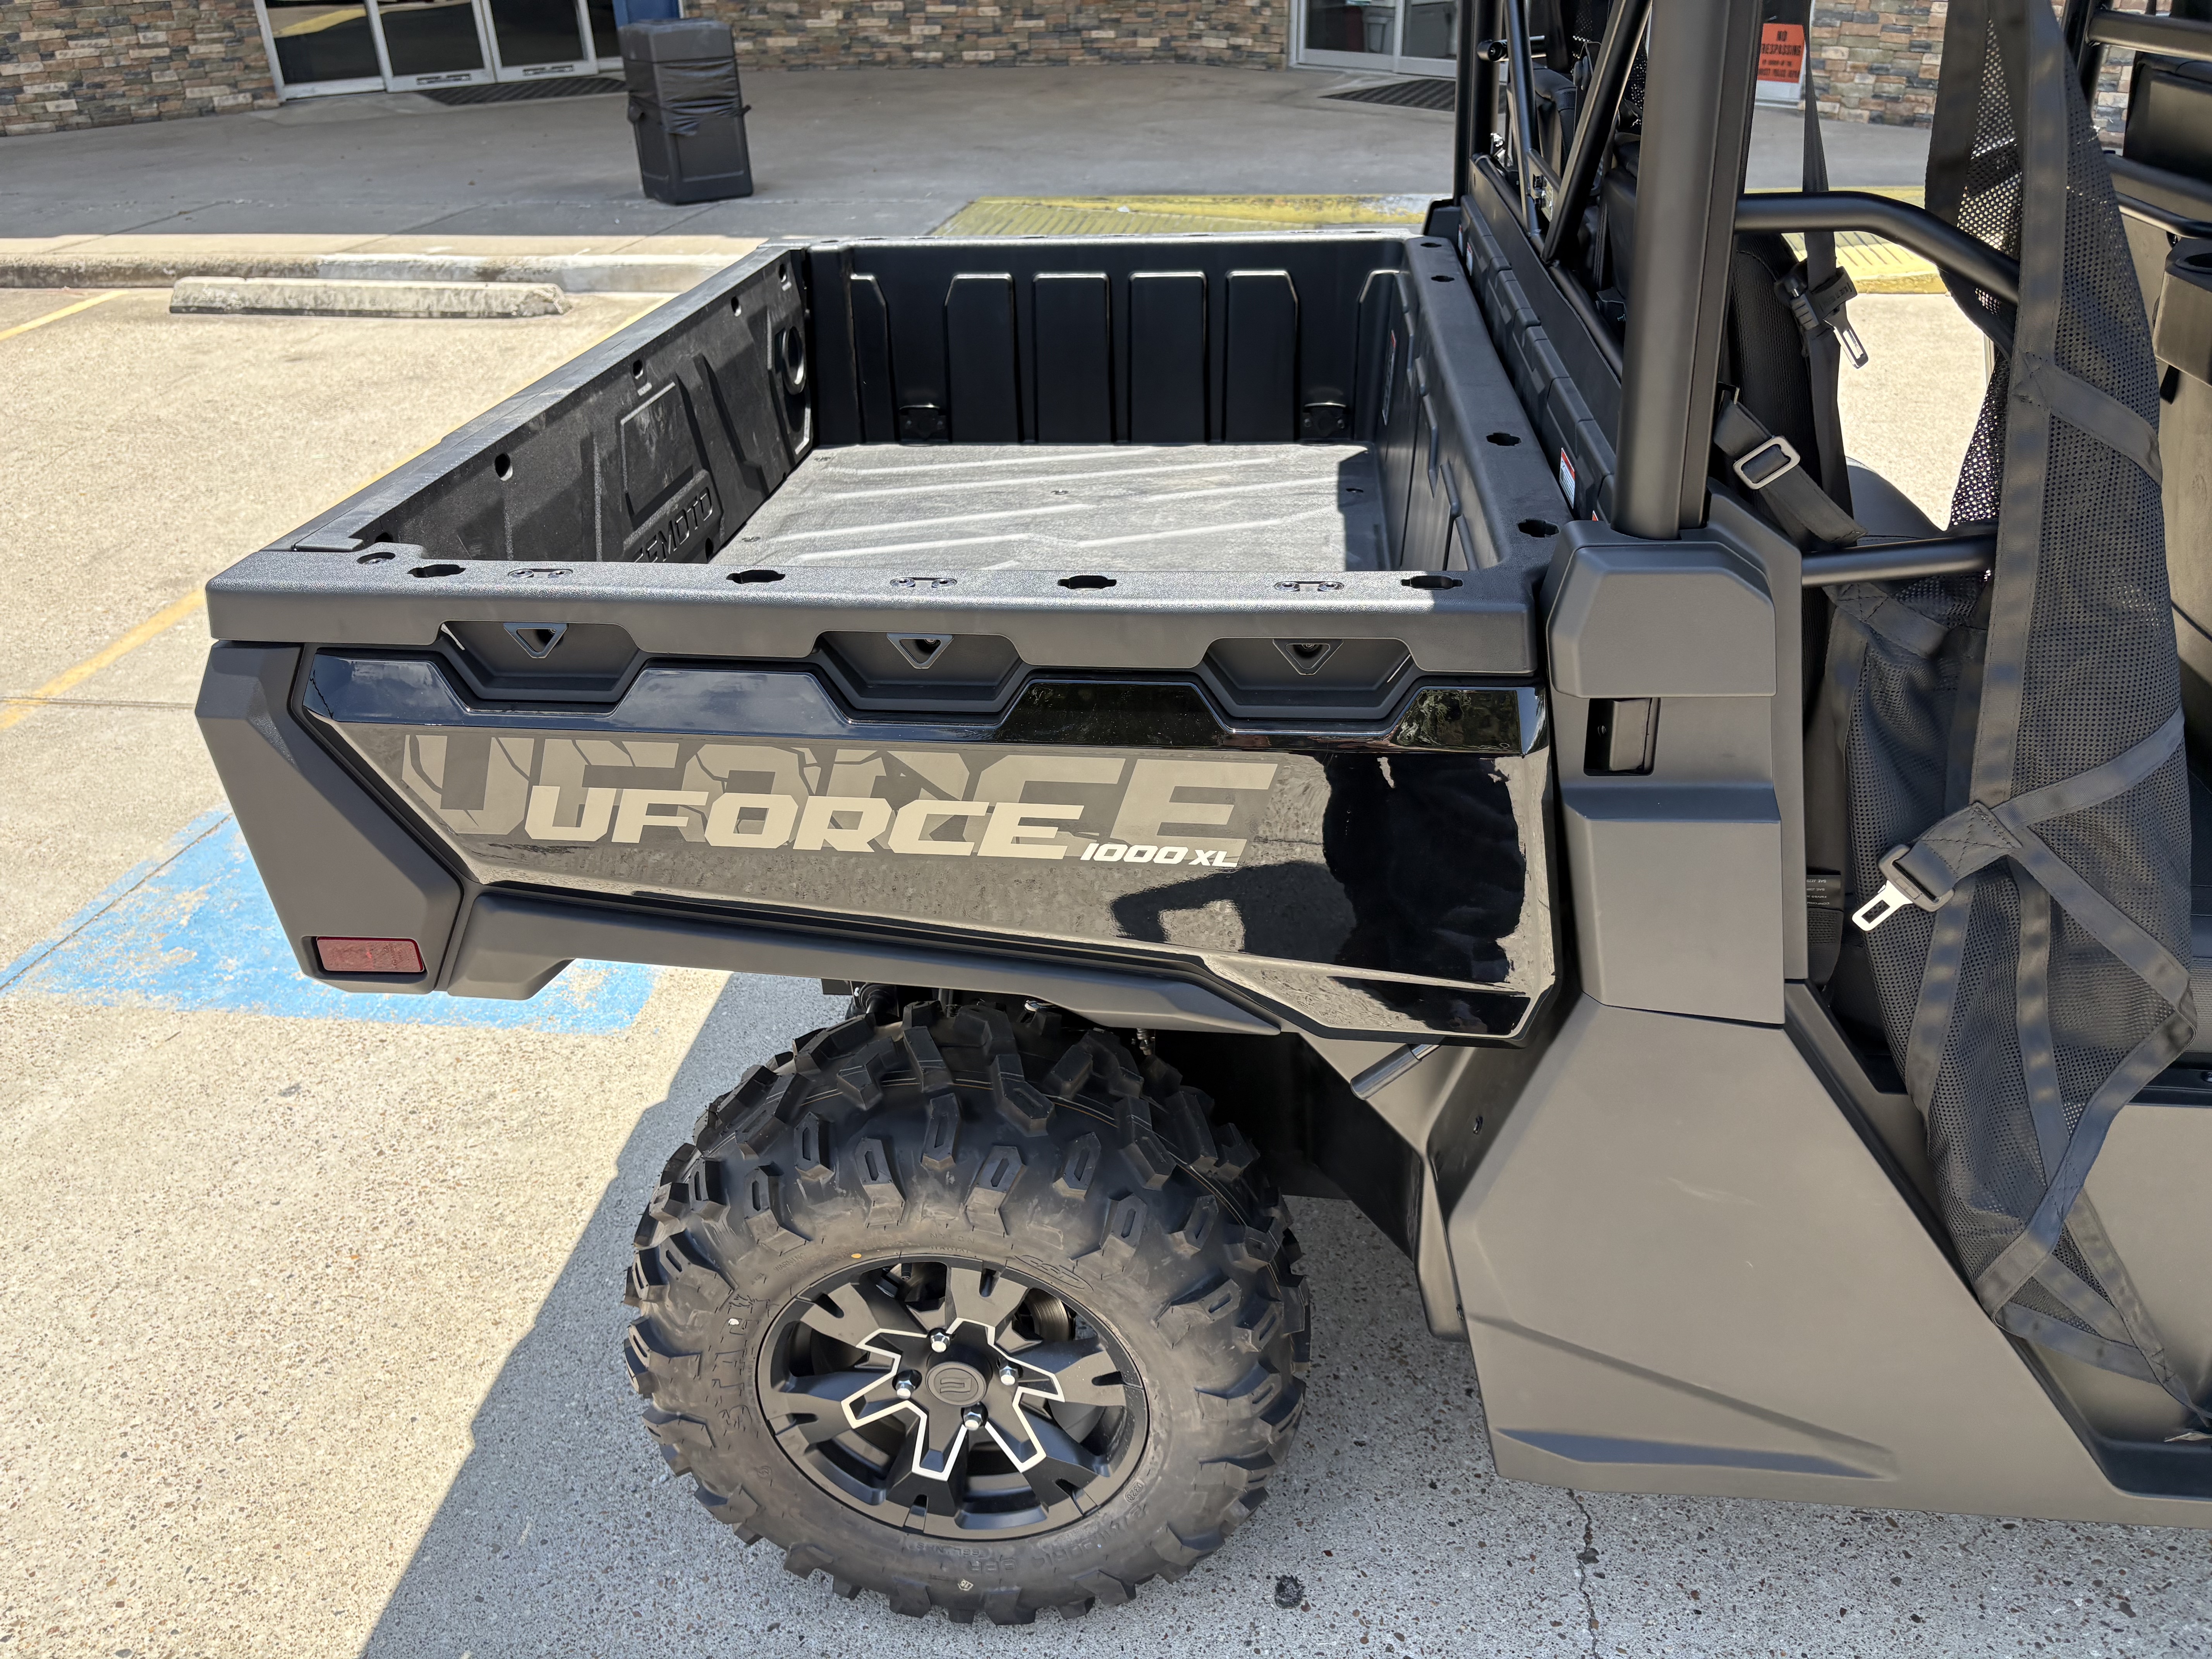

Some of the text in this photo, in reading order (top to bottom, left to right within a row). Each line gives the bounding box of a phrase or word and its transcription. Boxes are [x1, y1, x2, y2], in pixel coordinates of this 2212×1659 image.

[1777, 31, 1787, 41] NO
[524, 785, 1084, 859] UFORCE
[1080, 843, 1240, 868] 1000 XL
